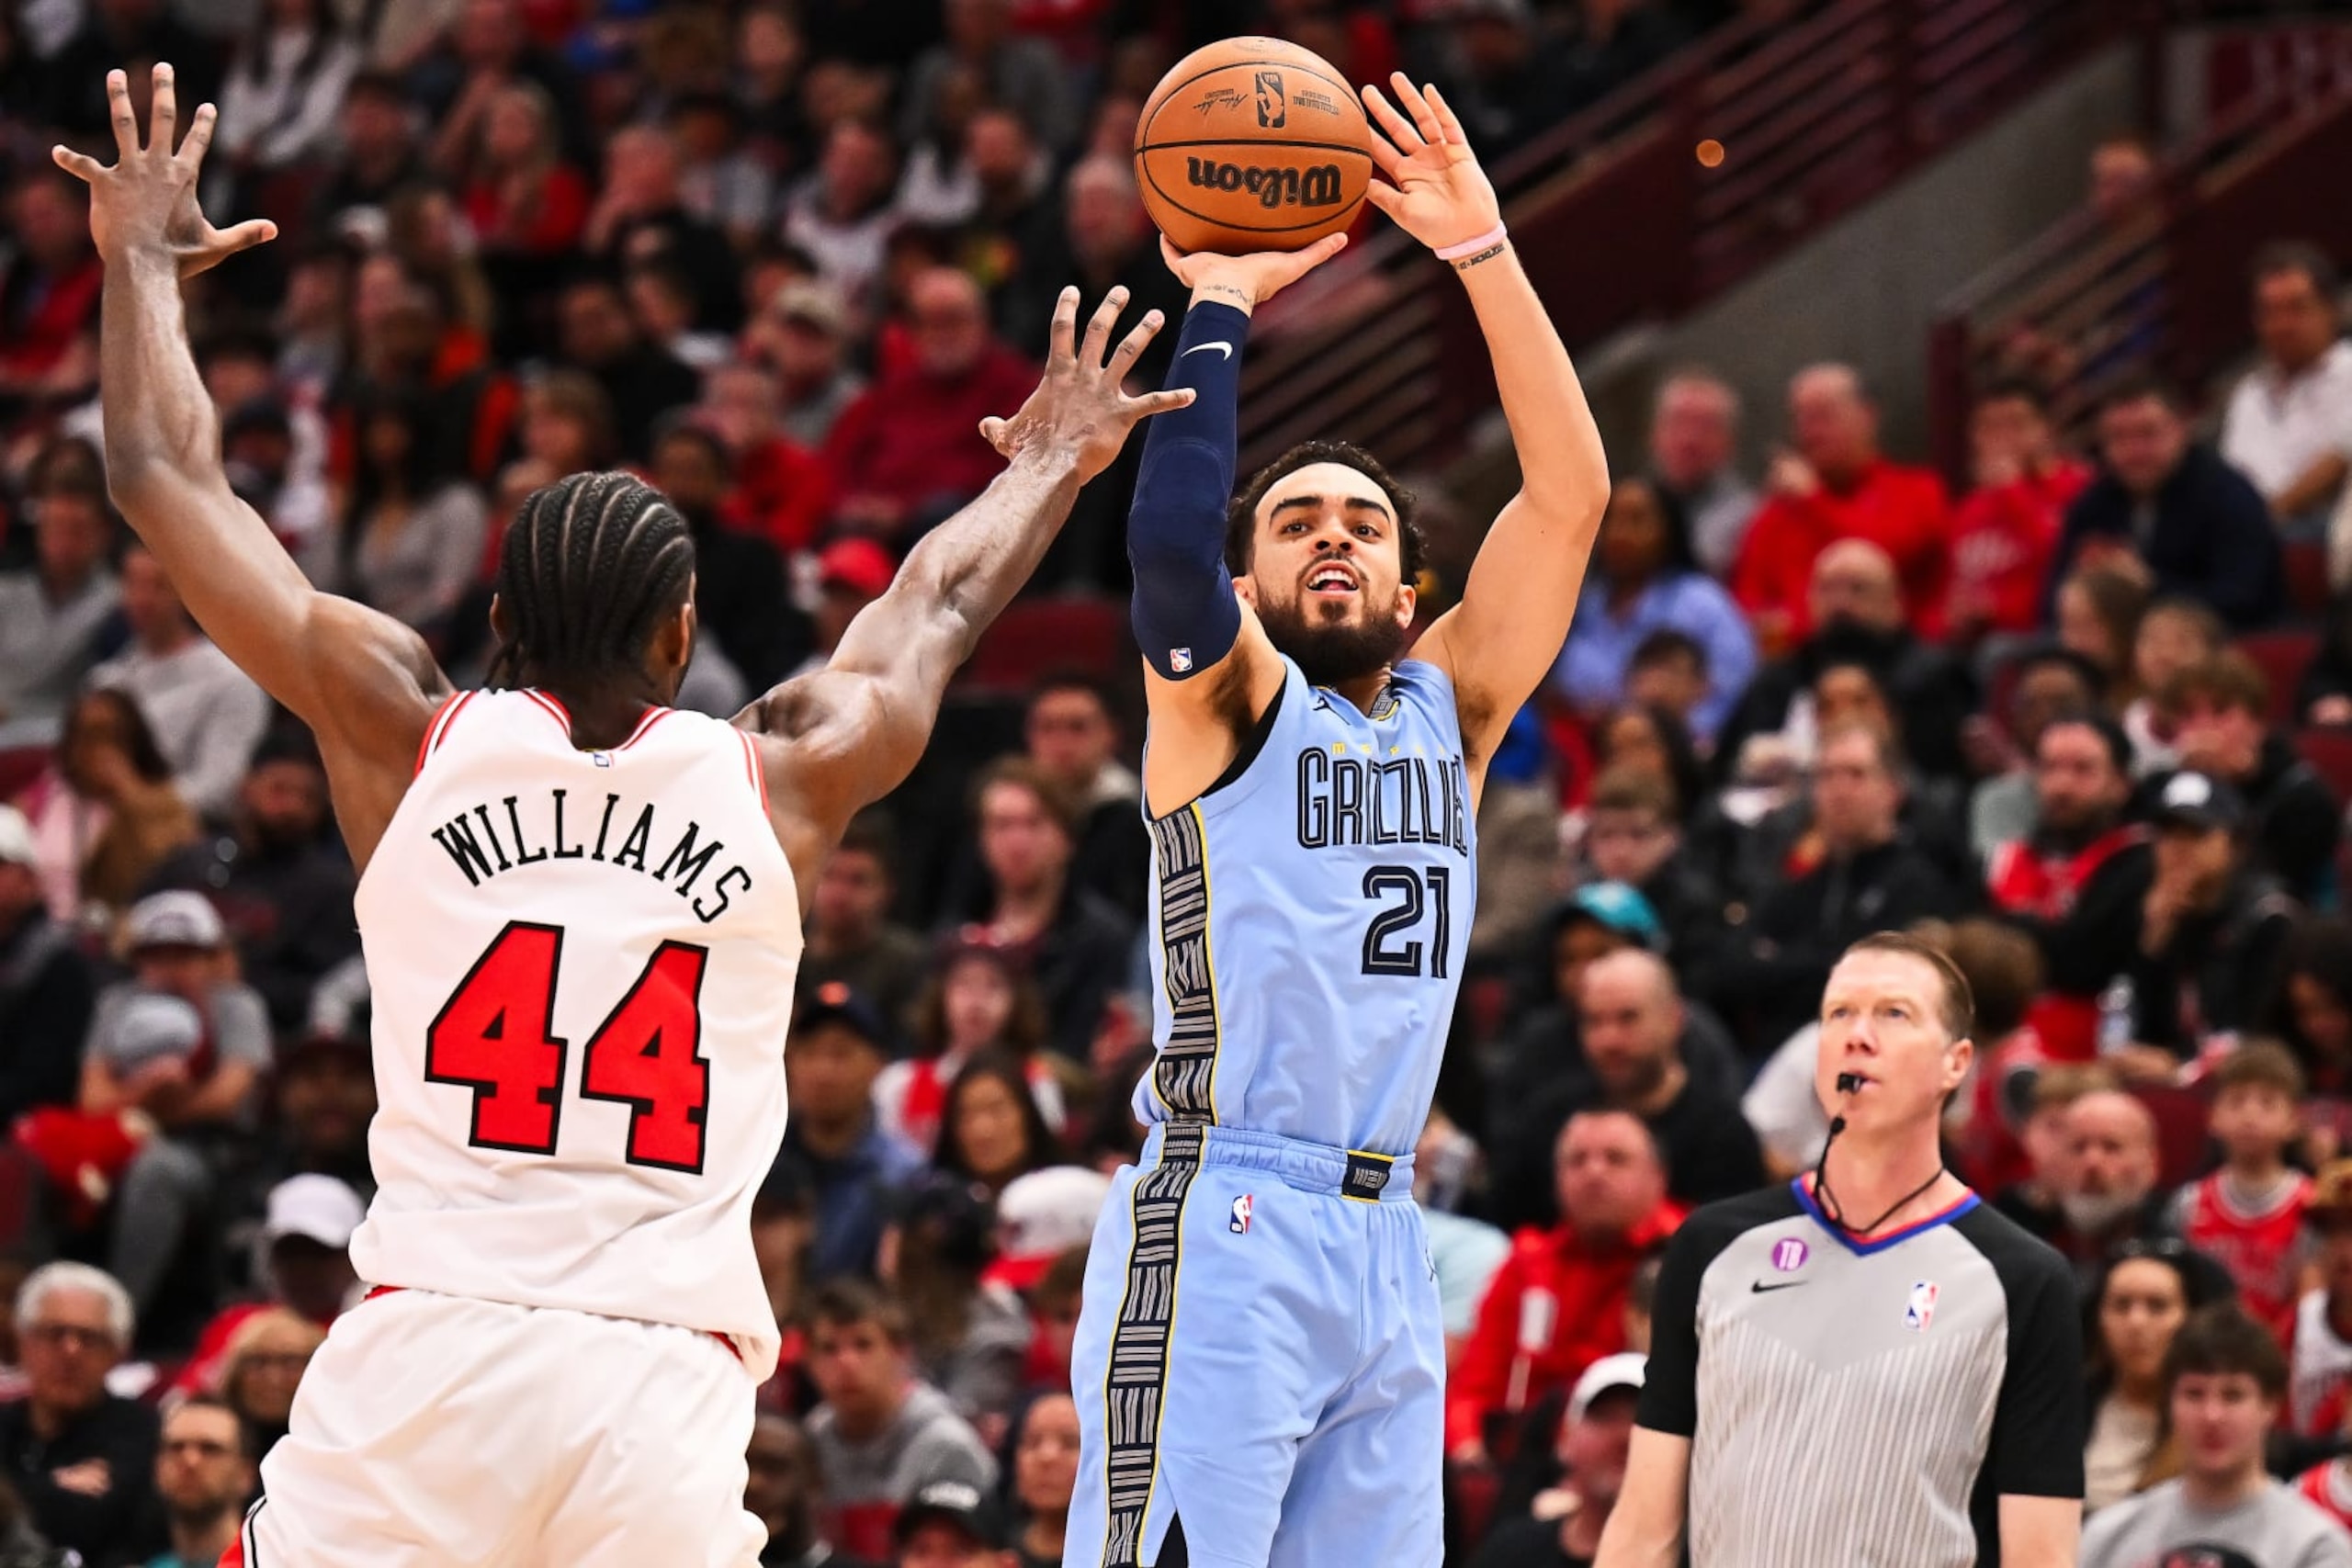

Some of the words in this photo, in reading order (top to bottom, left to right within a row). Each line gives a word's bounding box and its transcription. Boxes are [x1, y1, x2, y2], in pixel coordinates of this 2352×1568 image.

[1187, 156, 1342, 209] Wilson
[431, 789, 752, 923] WILLIAMS
[1361, 864, 1450, 979] 21
[424, 919, 710, 1176] 44
